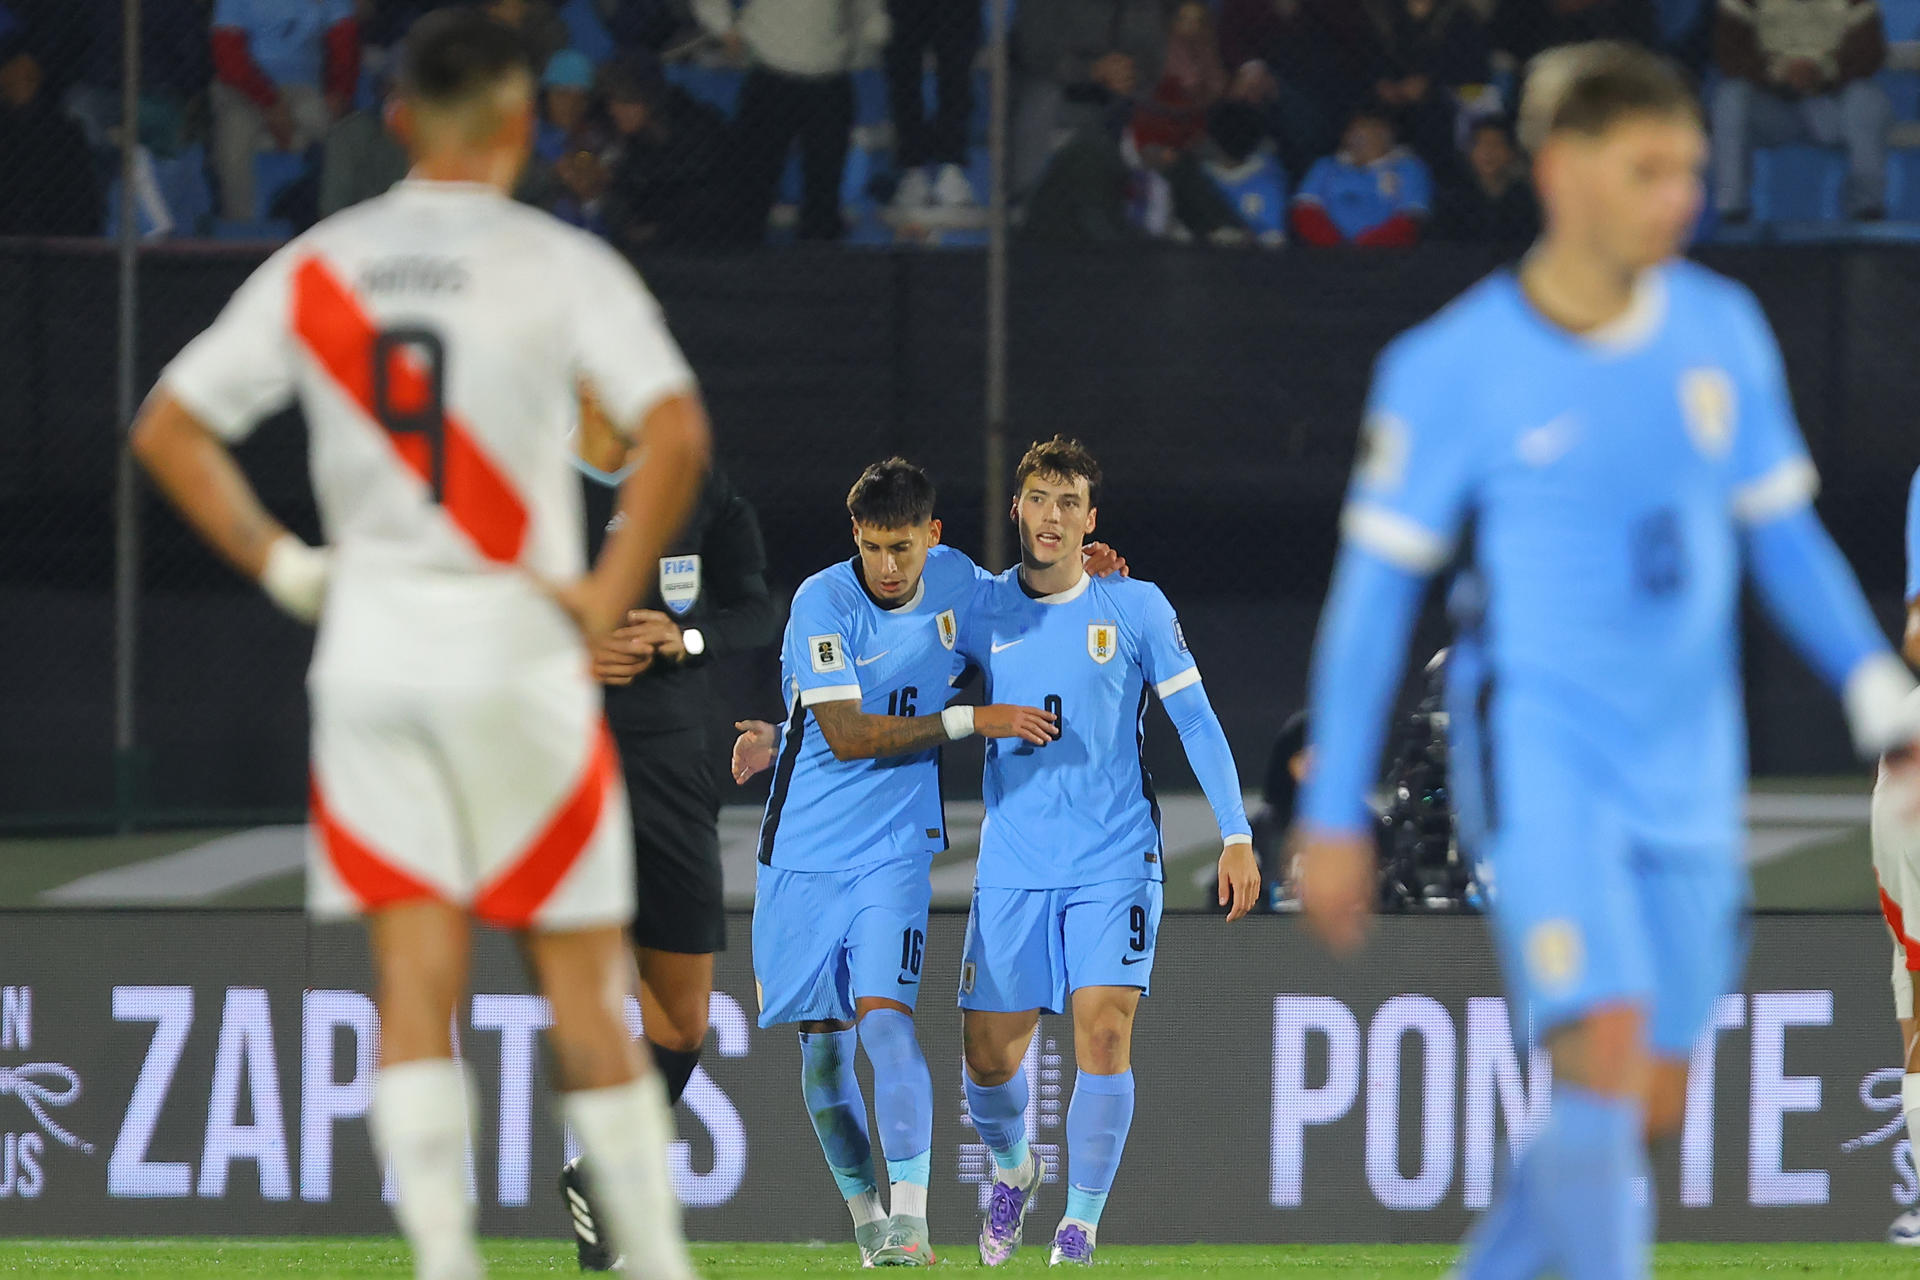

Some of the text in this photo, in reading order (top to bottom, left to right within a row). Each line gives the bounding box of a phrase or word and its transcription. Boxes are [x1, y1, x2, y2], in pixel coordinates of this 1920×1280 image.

[372, 326, 446, 504] 9
[663, 559, 695, 575] FIFA
[901, 926, 924, 976] 16
[1129, 905, 1145, 952] 9
[107, 985, 750, 1208] ZAPTS
